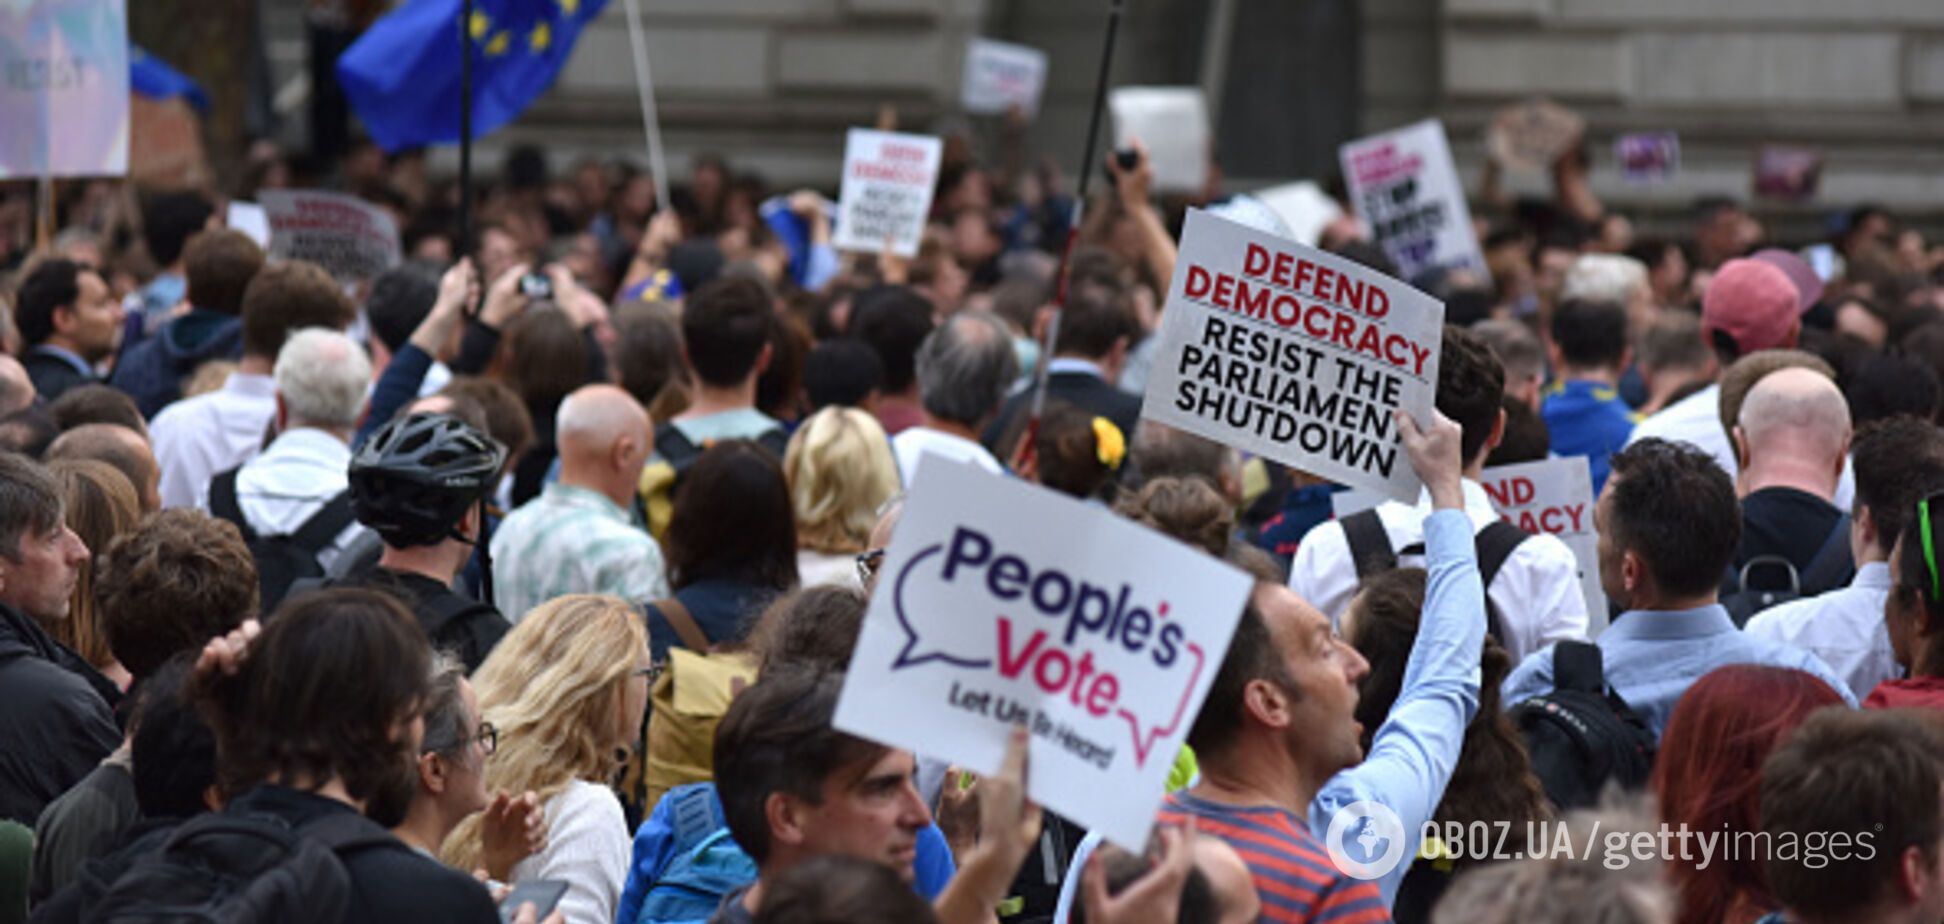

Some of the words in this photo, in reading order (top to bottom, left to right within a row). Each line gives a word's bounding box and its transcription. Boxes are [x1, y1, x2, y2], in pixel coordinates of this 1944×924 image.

[1184, 265, 1430, 375] DEMOCRACY
[1244, 243, 1389, 319] DEFEND
[1203, 317, 1325, 379] RESIST
[1336, 358, 1402, 407] THE
[1175, 381, 1397, 479] SHUTDOWN
[941, 526, 1184, 668] People's
[996, 616, 1119, 717] Vote
[949, 681, 991, 716] Let
[995, 697, 1029, 724] Us
[1056, 724, 1116, 771] Heard
